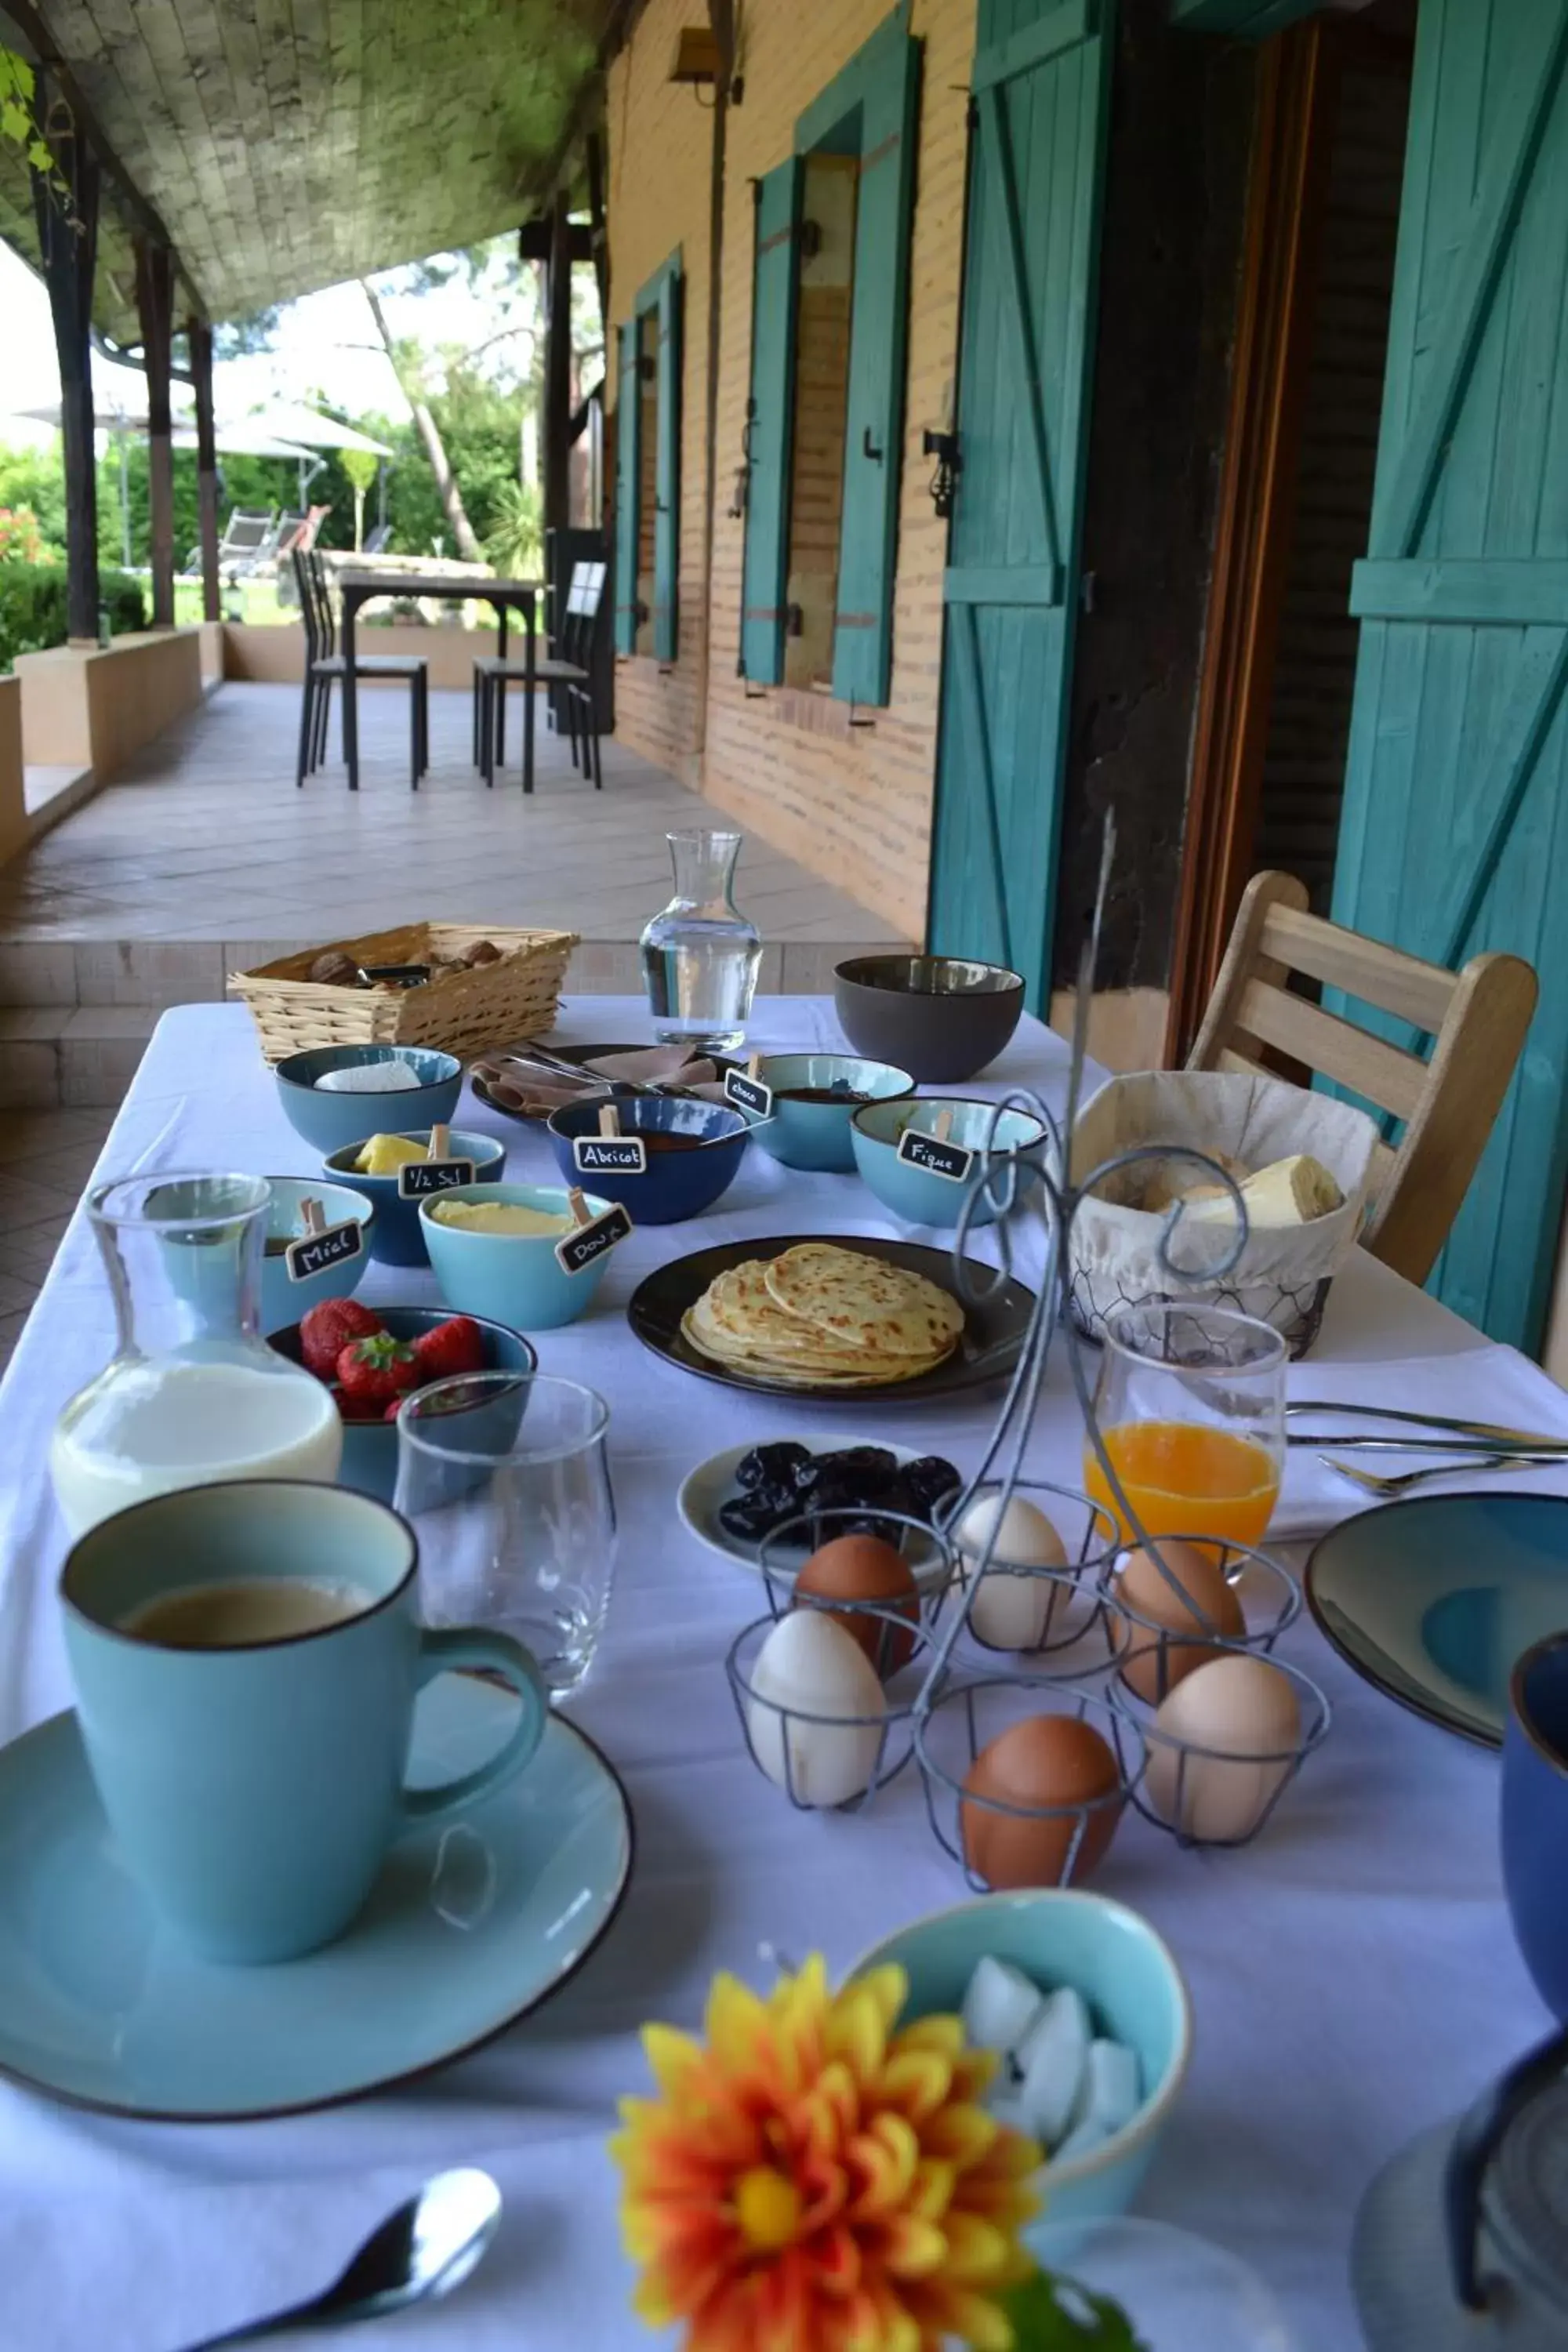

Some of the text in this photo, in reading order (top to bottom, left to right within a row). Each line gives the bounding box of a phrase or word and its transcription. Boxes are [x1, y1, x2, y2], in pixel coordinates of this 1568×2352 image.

[584, 1145, 639, 1165] Abricot
[912, 1145, 953, 1170] Figue
[302, 1231, 350, 1270] Miel
